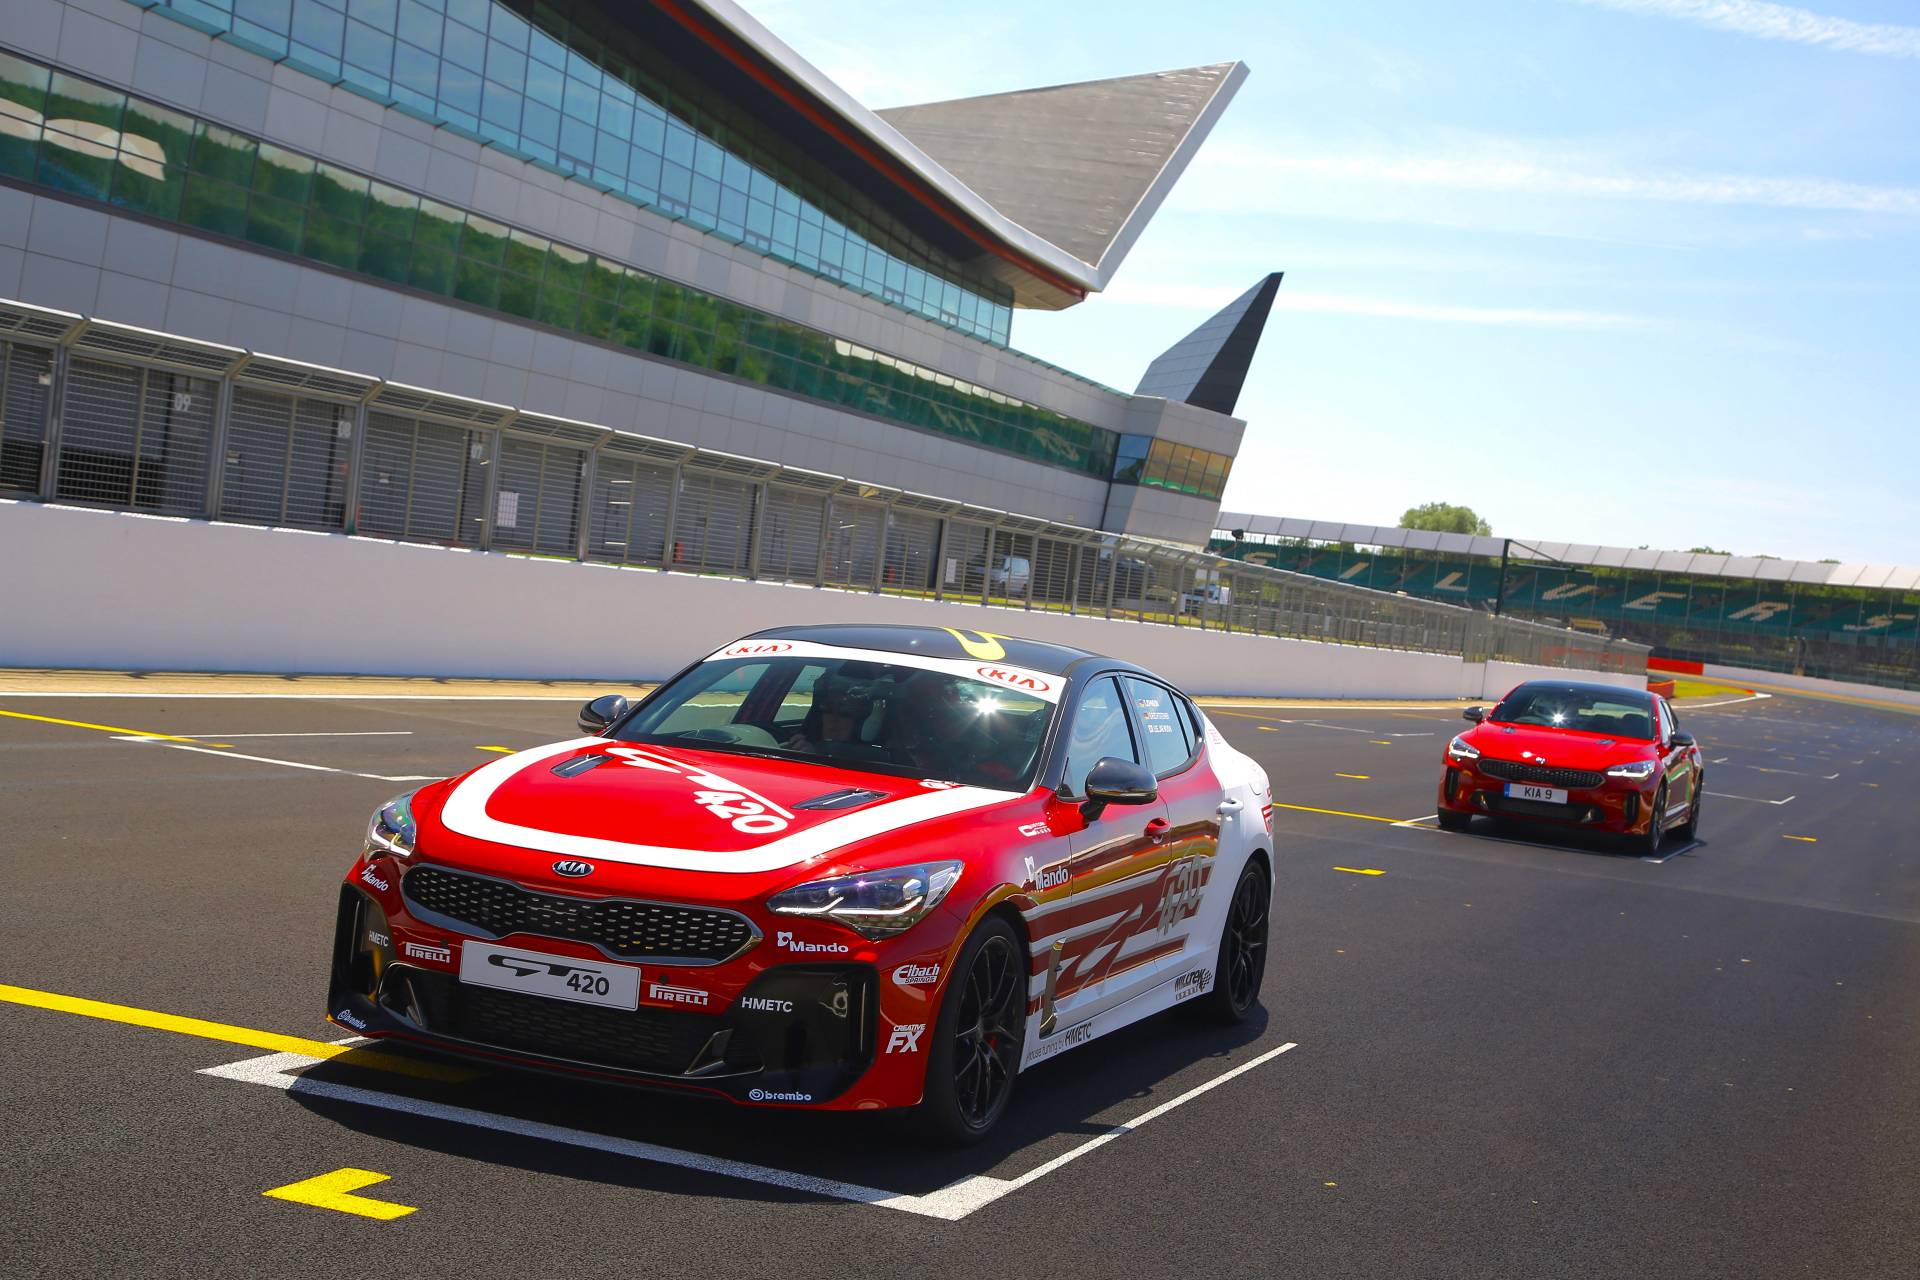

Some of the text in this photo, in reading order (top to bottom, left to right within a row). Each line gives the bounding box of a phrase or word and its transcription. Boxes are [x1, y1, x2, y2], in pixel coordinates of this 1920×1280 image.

[736, 644, 779, 655] KIA
[988, 667, 1038, 690] KIA
[1524, 786, 1553, 800] KIA 9
[692, 789, 789, 834] 420
[556, 861, 587, 874] KIA
[1035, 865, 1069, 891] Mando
[363, 871, 389, 892] Mando
[368, 929, 389, 948] HMETC
[790, 941, 849, 953] Mando
[405, 942, 451, 963] PIRELLI
[566, 973, 610, 996] 420
[649, 984, 708, 1005] PIRELLI
[741, 997, 793, 1013] HMETC
[893, 1023, 926, 1032] CREATIVE
[1065, 1022, 1092, 1046] HMETC
[885, 1029, 924, 1053] FX
[764, 1090, 812, 1101] brembo
